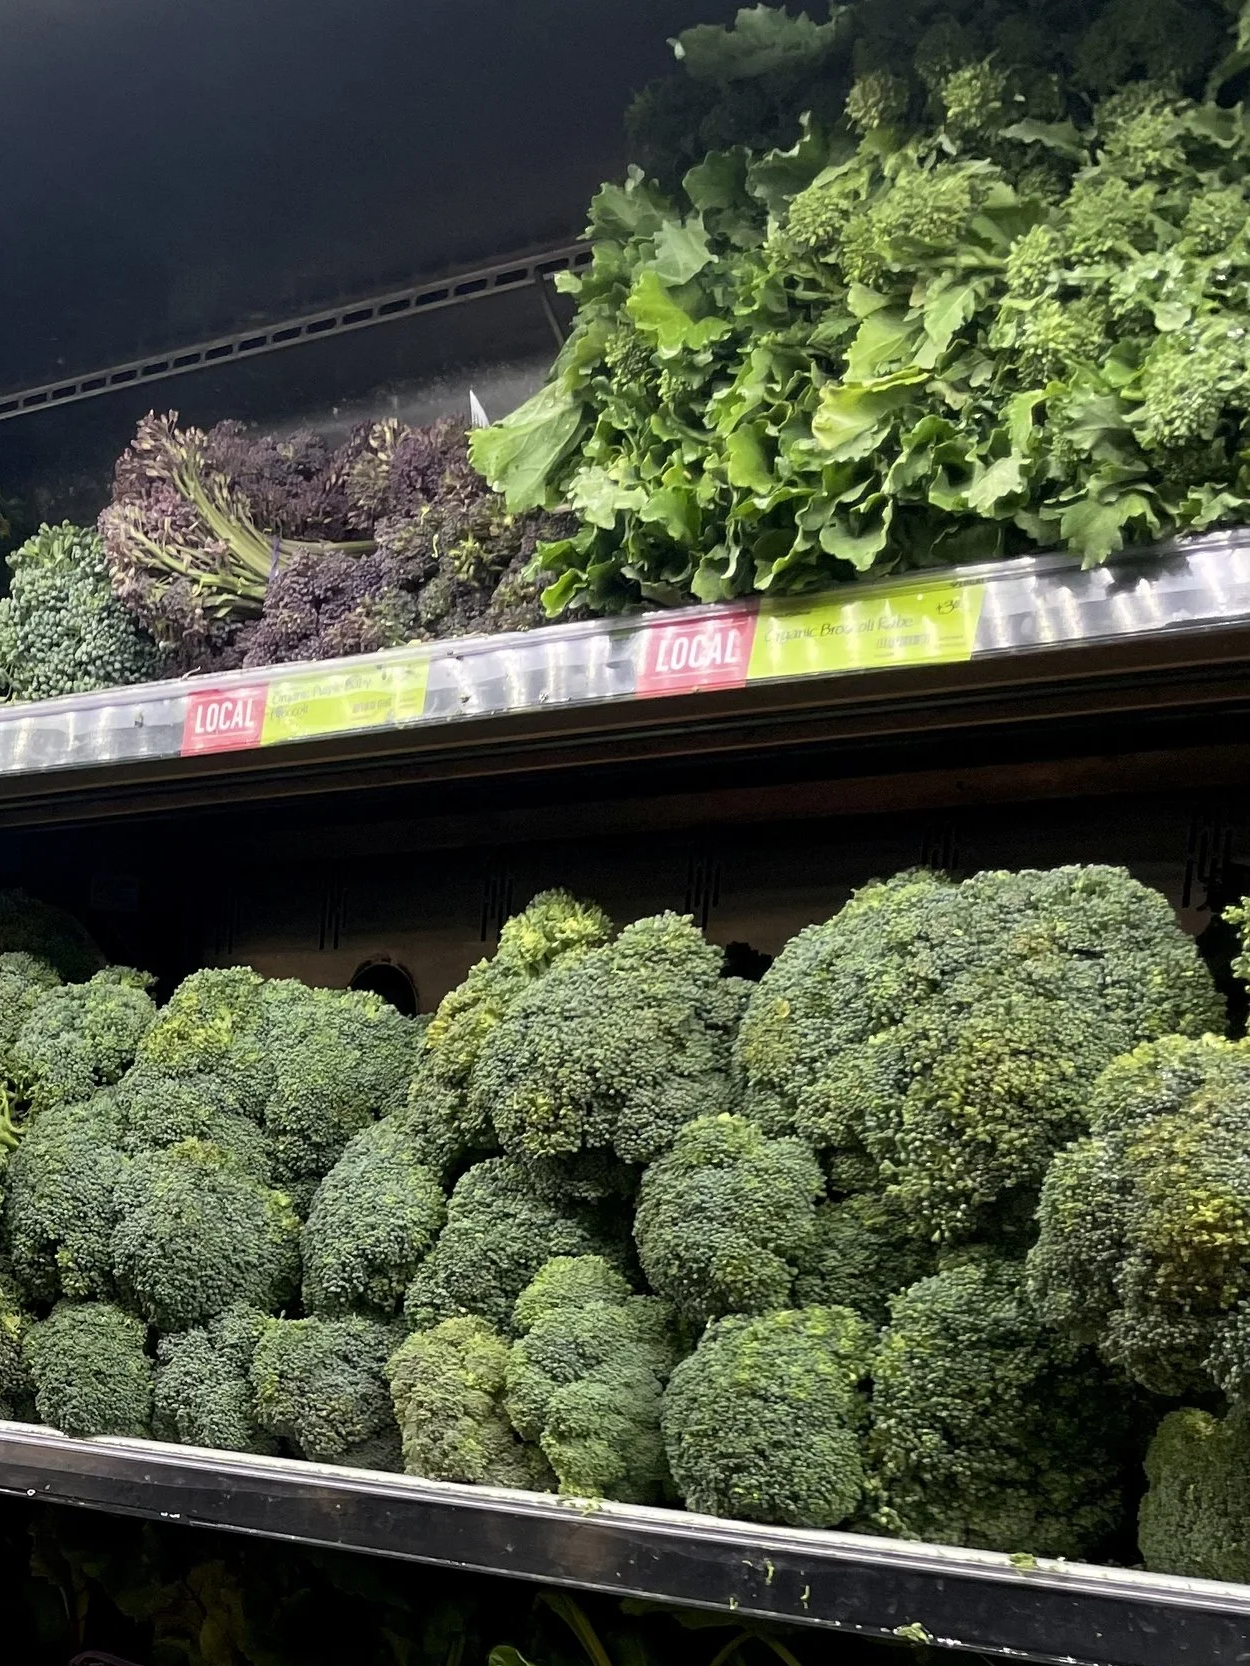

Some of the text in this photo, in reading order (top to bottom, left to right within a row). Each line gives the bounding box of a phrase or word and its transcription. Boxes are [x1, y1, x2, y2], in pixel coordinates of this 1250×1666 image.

[820, 619, 874, 637] Brocoli
[655, 627, 739, 673] LOCAL
[194, 700, 255, 734] LOCAL
